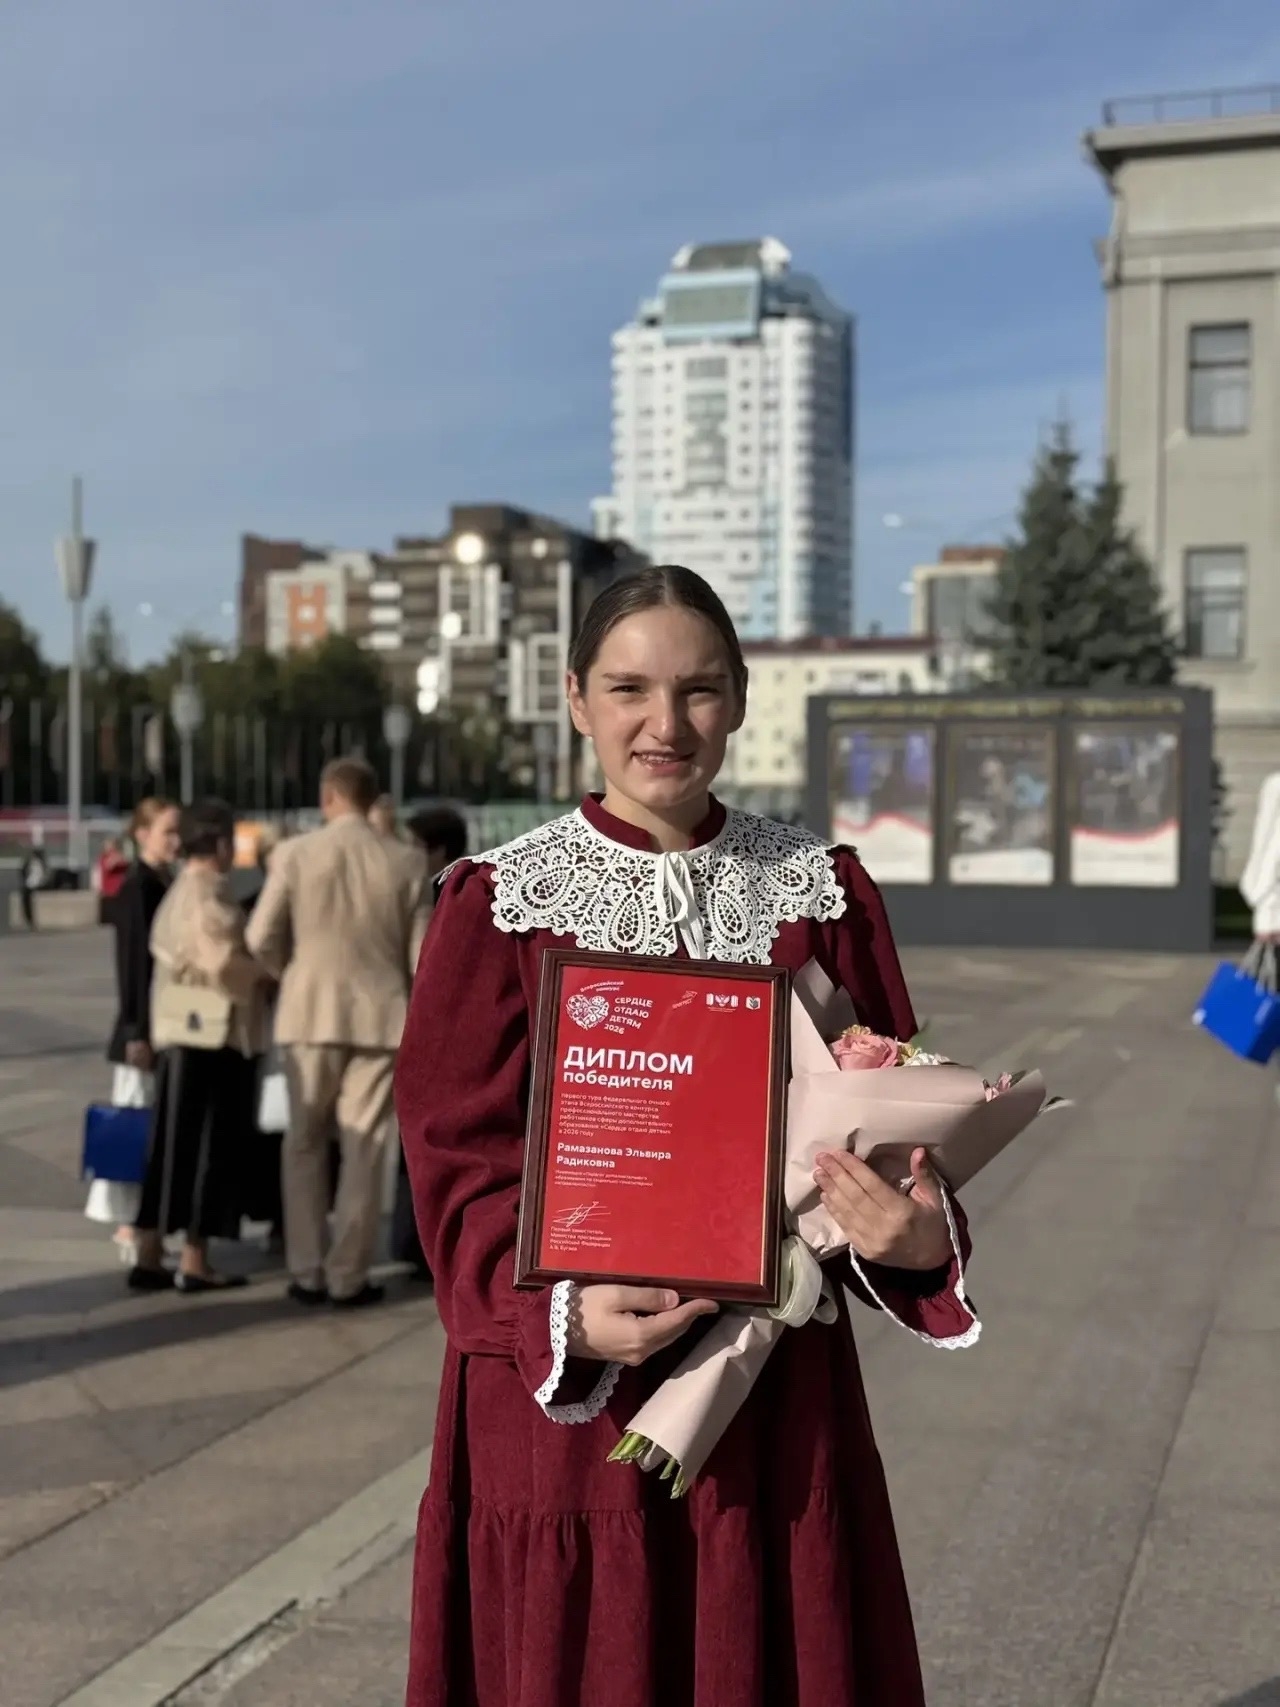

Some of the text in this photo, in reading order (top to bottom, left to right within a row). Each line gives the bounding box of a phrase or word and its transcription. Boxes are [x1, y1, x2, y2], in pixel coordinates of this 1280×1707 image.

[614, 997, 654, 1008] СЕРДЦЕ
[614, 1006, 650, 1019] ОТДАЮ
[604, 1023, 625, 1035] 2026
[609, 1015, 642, 1030] ДЕТЯМ
[563, 1045, 693, 1075] ДИПЛОМ
[563, 1070, 673, 1091] победителя
[602, 1096, 647, 1104] федерального
[557, 1142, 672, 1161] Рамазанова Эльвира
[556, 1155, 616, 1168] Радиковна
